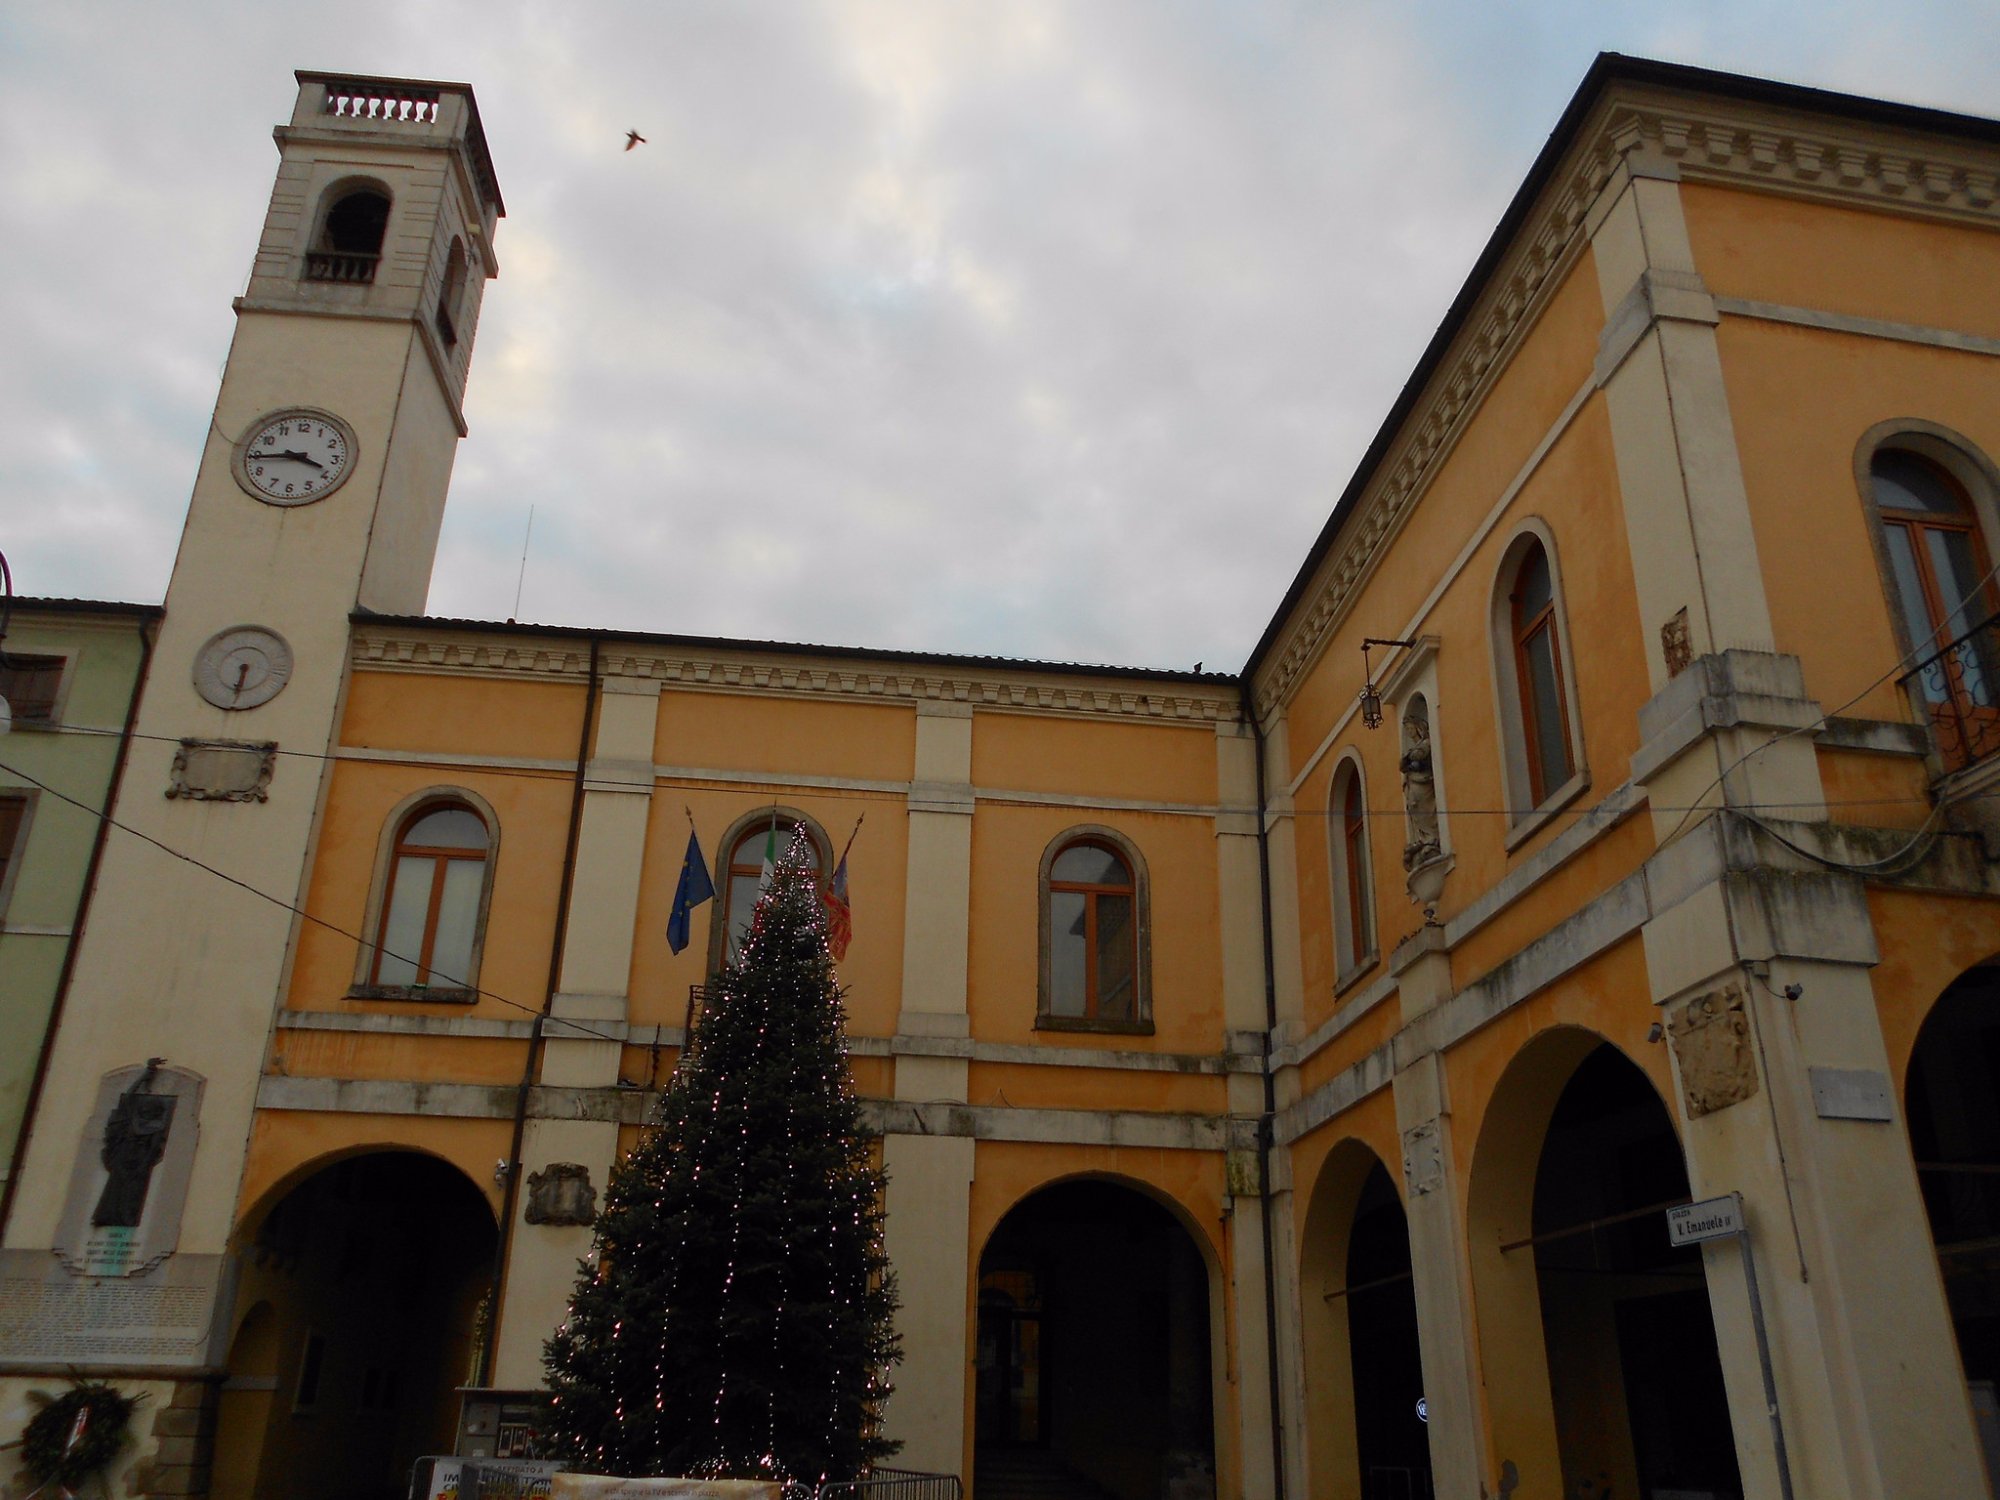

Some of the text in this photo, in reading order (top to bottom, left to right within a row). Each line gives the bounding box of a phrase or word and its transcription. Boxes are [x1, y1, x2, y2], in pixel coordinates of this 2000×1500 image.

[279, 425, 289, 436] 11
[298, 423, 310, 433] 12
[318, 428, 323, 437] 1
[263, 435, 275, 445] 10
[327, 439, 337, 449] 2
[331, 454, 340, 465] 3
[255, 466, 264, 476] 8
[320, 470, 329, 480] 4
[269, 478, 279, 488] 7
[285, 483, 294, 493] 6
[304, 481, 313, 490] 5
[1686, 1215, 1723, 1234] Emanuele
